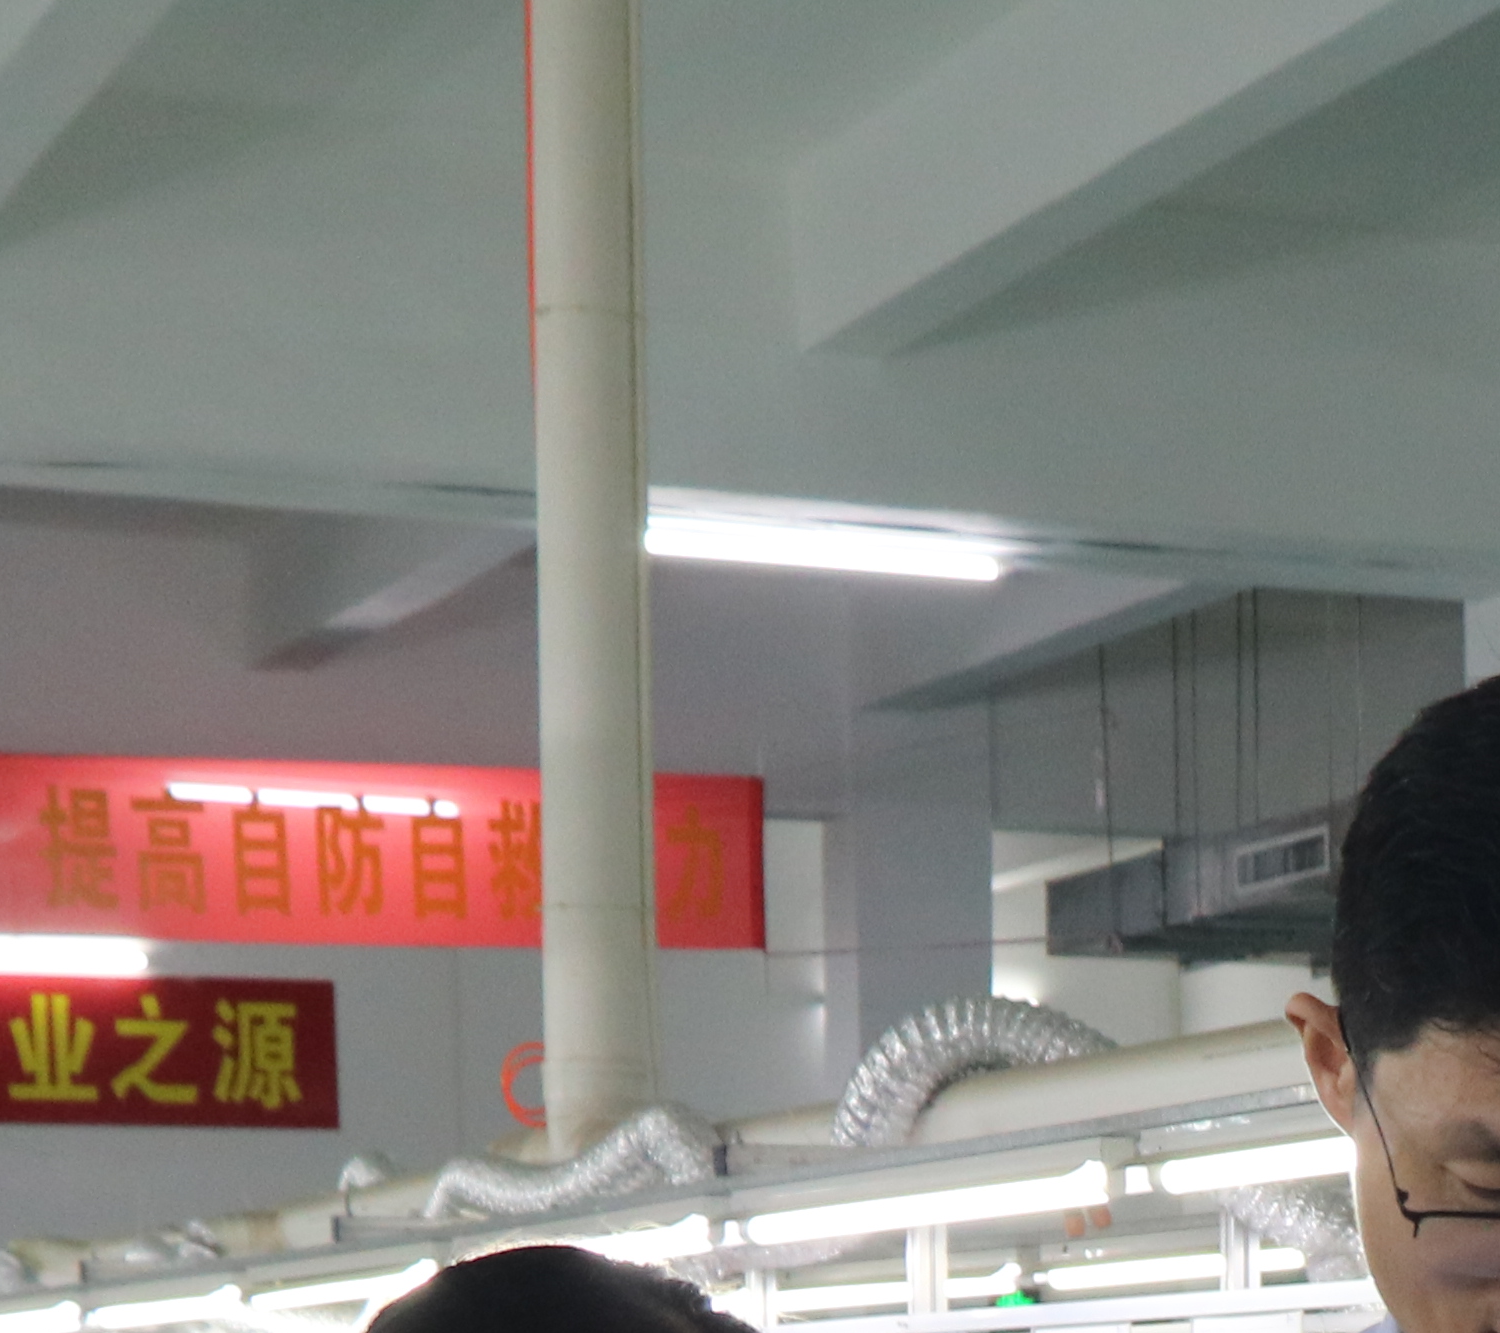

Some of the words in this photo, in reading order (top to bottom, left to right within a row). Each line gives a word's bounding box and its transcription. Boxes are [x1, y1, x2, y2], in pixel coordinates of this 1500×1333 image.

[39, 784, 725, 921] 提高自防自救力
